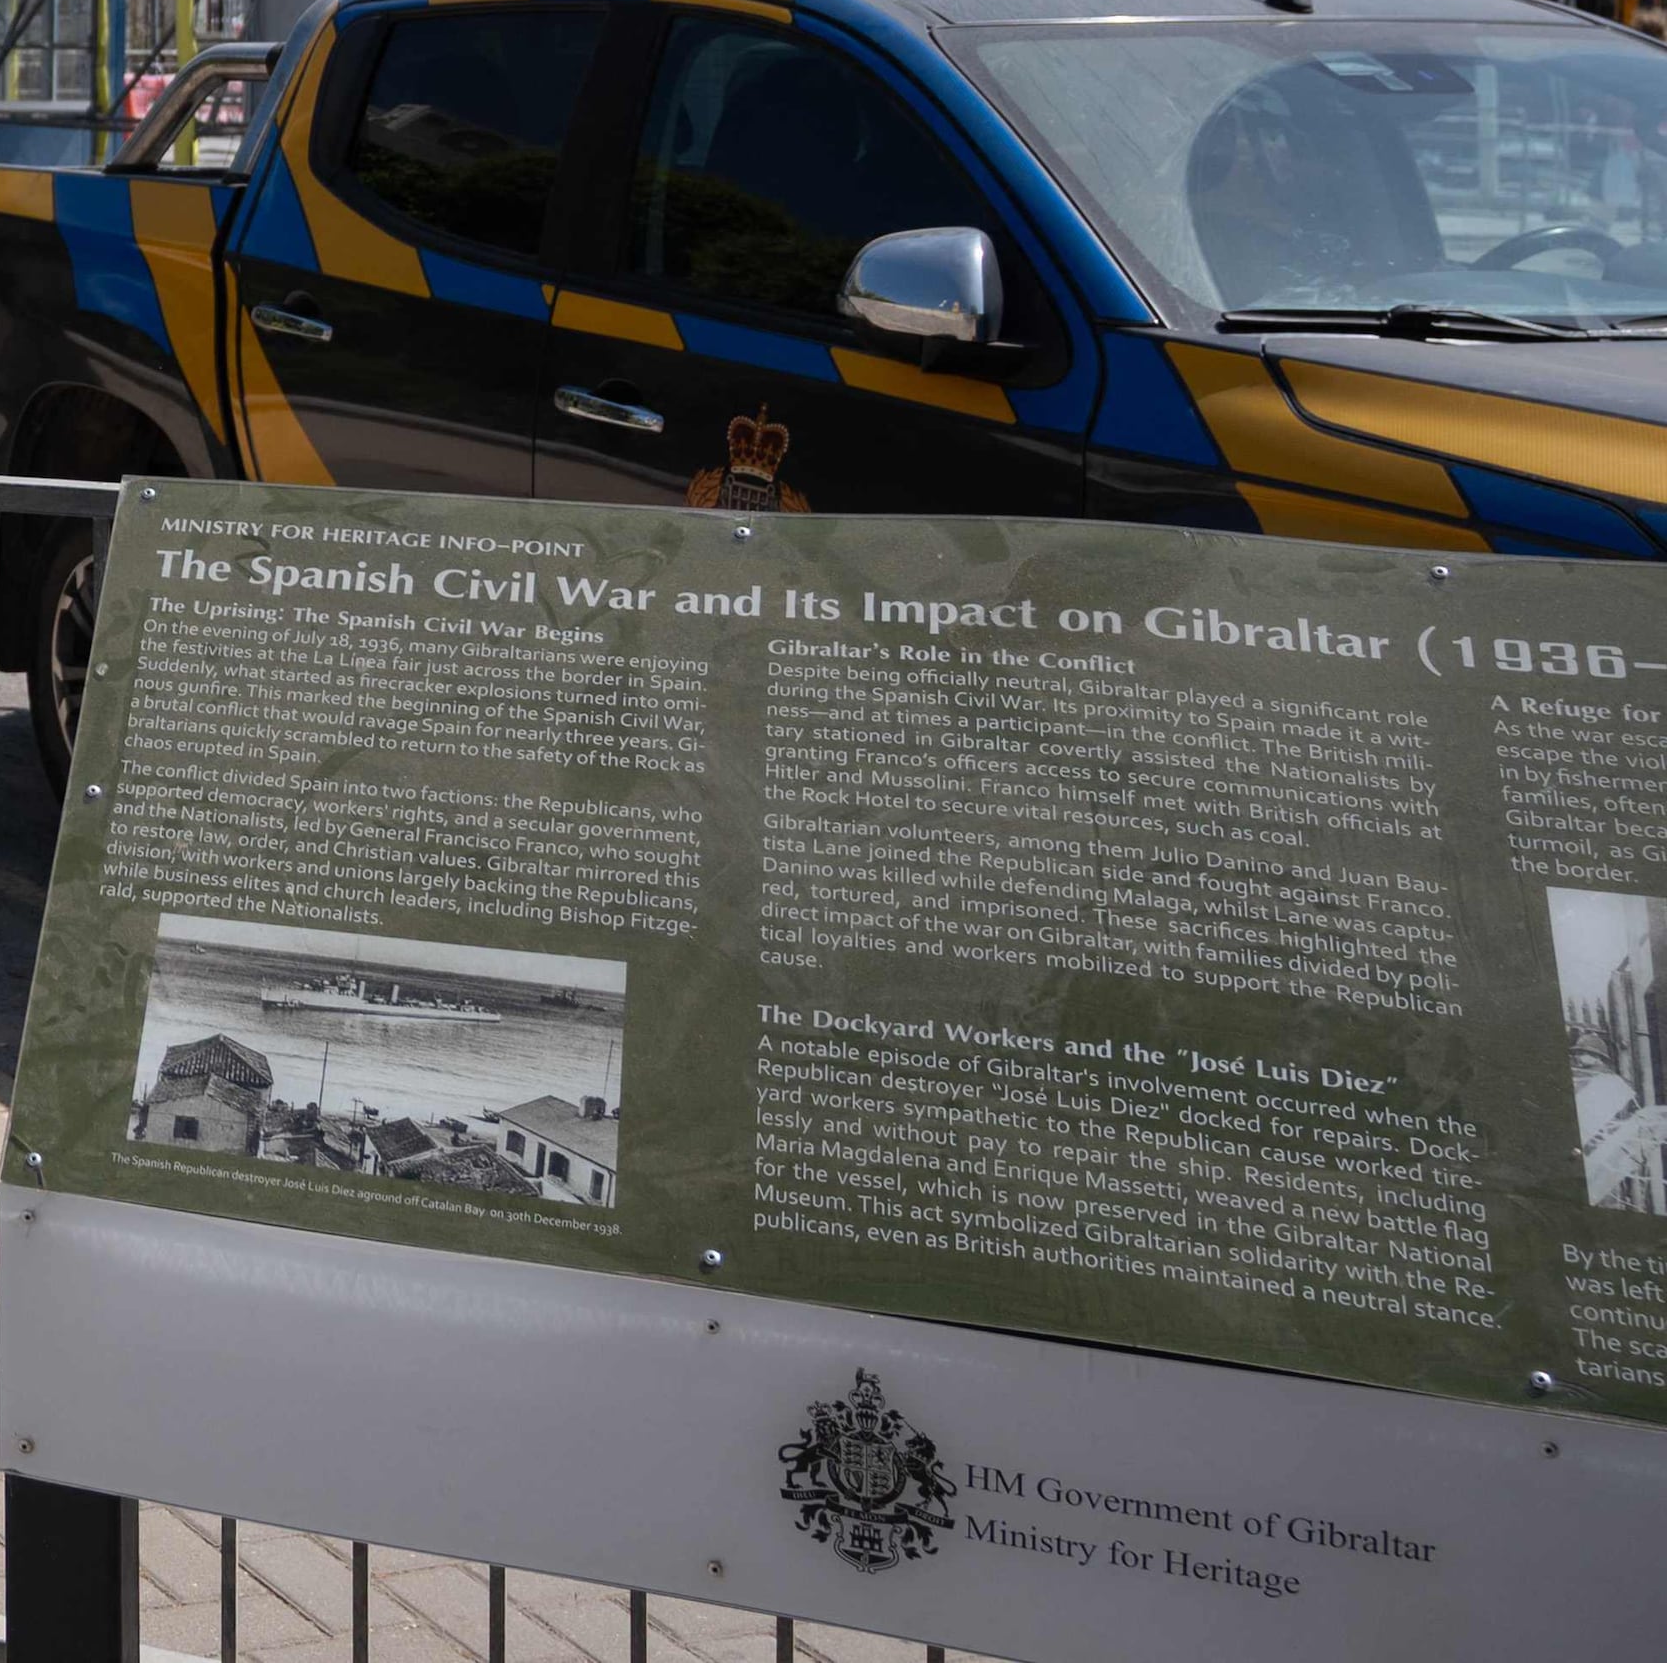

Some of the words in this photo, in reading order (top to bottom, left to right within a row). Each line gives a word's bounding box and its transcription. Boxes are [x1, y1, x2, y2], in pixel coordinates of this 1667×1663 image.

[160, 517, 264, 537] MINISTRY
[270, 523, 314, 541] FOR
[322, 527, 432, 548] HERITAGE
[439, 535, 585, 558] INFO-POINT
[150, 596, 186, 614] The
[193, 600, 284, 625] Uprising:
[293, 607, 330, 625] The
[337, 610, 416, 631] Spanish
[423, 617, 472, 635] Civil
[480, 620, 526, 638] War
[534, 624, 604, 647] Begins
[157, 549, 231, 583] The
[248, 555, 414, 596] Spanish
[433, 568, 536, 605] Civil
[556, 575, 656, 611] War
[674, 585, 762, 617] and
[785, 589, 841, 621] Its
[863, 591, 1038, 635] Impact
[1058, 608, 1122, 635] on
[1144, 606, 1390, 660] Gibraltar
[899, 644, 951, 663] Role
[960, 646, 982, 665] in
[992, 648, 1030, 667] the
[1038, 652, 1135, 675] Conflict
[768, 661, 841, 682] Despite
[846, 665, 901, 687] being
[906, 667, 990, 692] officially
[995, 676, 1072, 697] neutral,
[1078, 679, 1170, 701] Gibraltar
[1176, 687, 1245, 710] played
[1252, 698, 1264, 711] a
[1270, 697, 1381, 723] significant
[1387, 710, 1428, 728] role
[1490, 694, 1510, 712] A
[1520, 696, 1612, 724] Refuge
[1621, 703, 1661, 723] for
[120, 759, 152, 777] The
[155, 764, 220, 783] conflict
[222, 768, 286, 789] divided
[289, 774, 339, 795] Spain
[342, 779, 378, 797] into
[382, 784, 417, 800] two
[420, 785, 498, 807] factions:
[503, 792, 534, 810] the
[538, 795, 656, 823] Republicans,
[661, 805, 703, 823] who
[1510, 854, 1550, 875] the
[1554, 857, 1639, 883] border.
[757, 1004, 802, 1026] The
[813, 1009, 934, 1041] Dockyard
[944, 1023, 1055, 1053] Workers
[1064, 1038, 1113, 1059] and
[1122, 1041, 1166, 1066] the
[1256, 1059, 1310, 1085] Luis
[111, 1151, 131, 1165] The
[131, 1154, 172, 1171] Spanish
[173, 1161, 230, 1179] Republican
[231, 1169, 282, 1187] destroyer
[282, 1177, 307, 1191] José
[307, 1180, 330, 1193] Luis
[331, 1183, 356, 1198] Diez
[356, 1190, 403, 1205] aground
[403, 1195, 421, 1208] off
[420, 1196, 465, 1213] Catalan
[464, 1203, 486, 1218] Bay
[489, 1208, 505, 1220] on
[504, 1210, 532, 1223] 30th
[533, 1212, 592, 1231] December
[593, 1223, 623, 1237] 1938.
[1562, 1243, 1594, 1271] By
[1598, 1248, 1642, 1273] the
[965, 1463, 1025, 1498] HM
[1036, 1477, 1232, 1532] Government
[1243, 1512, 1282, 1538] of
[1287, 1517, 1436, 1563] Gibraltar
[965, 1515, 1097, 1567] Ministry
[1108, 1539, 1154, 1571] for
[1164, 1549, 1300, 1596] Heritage
